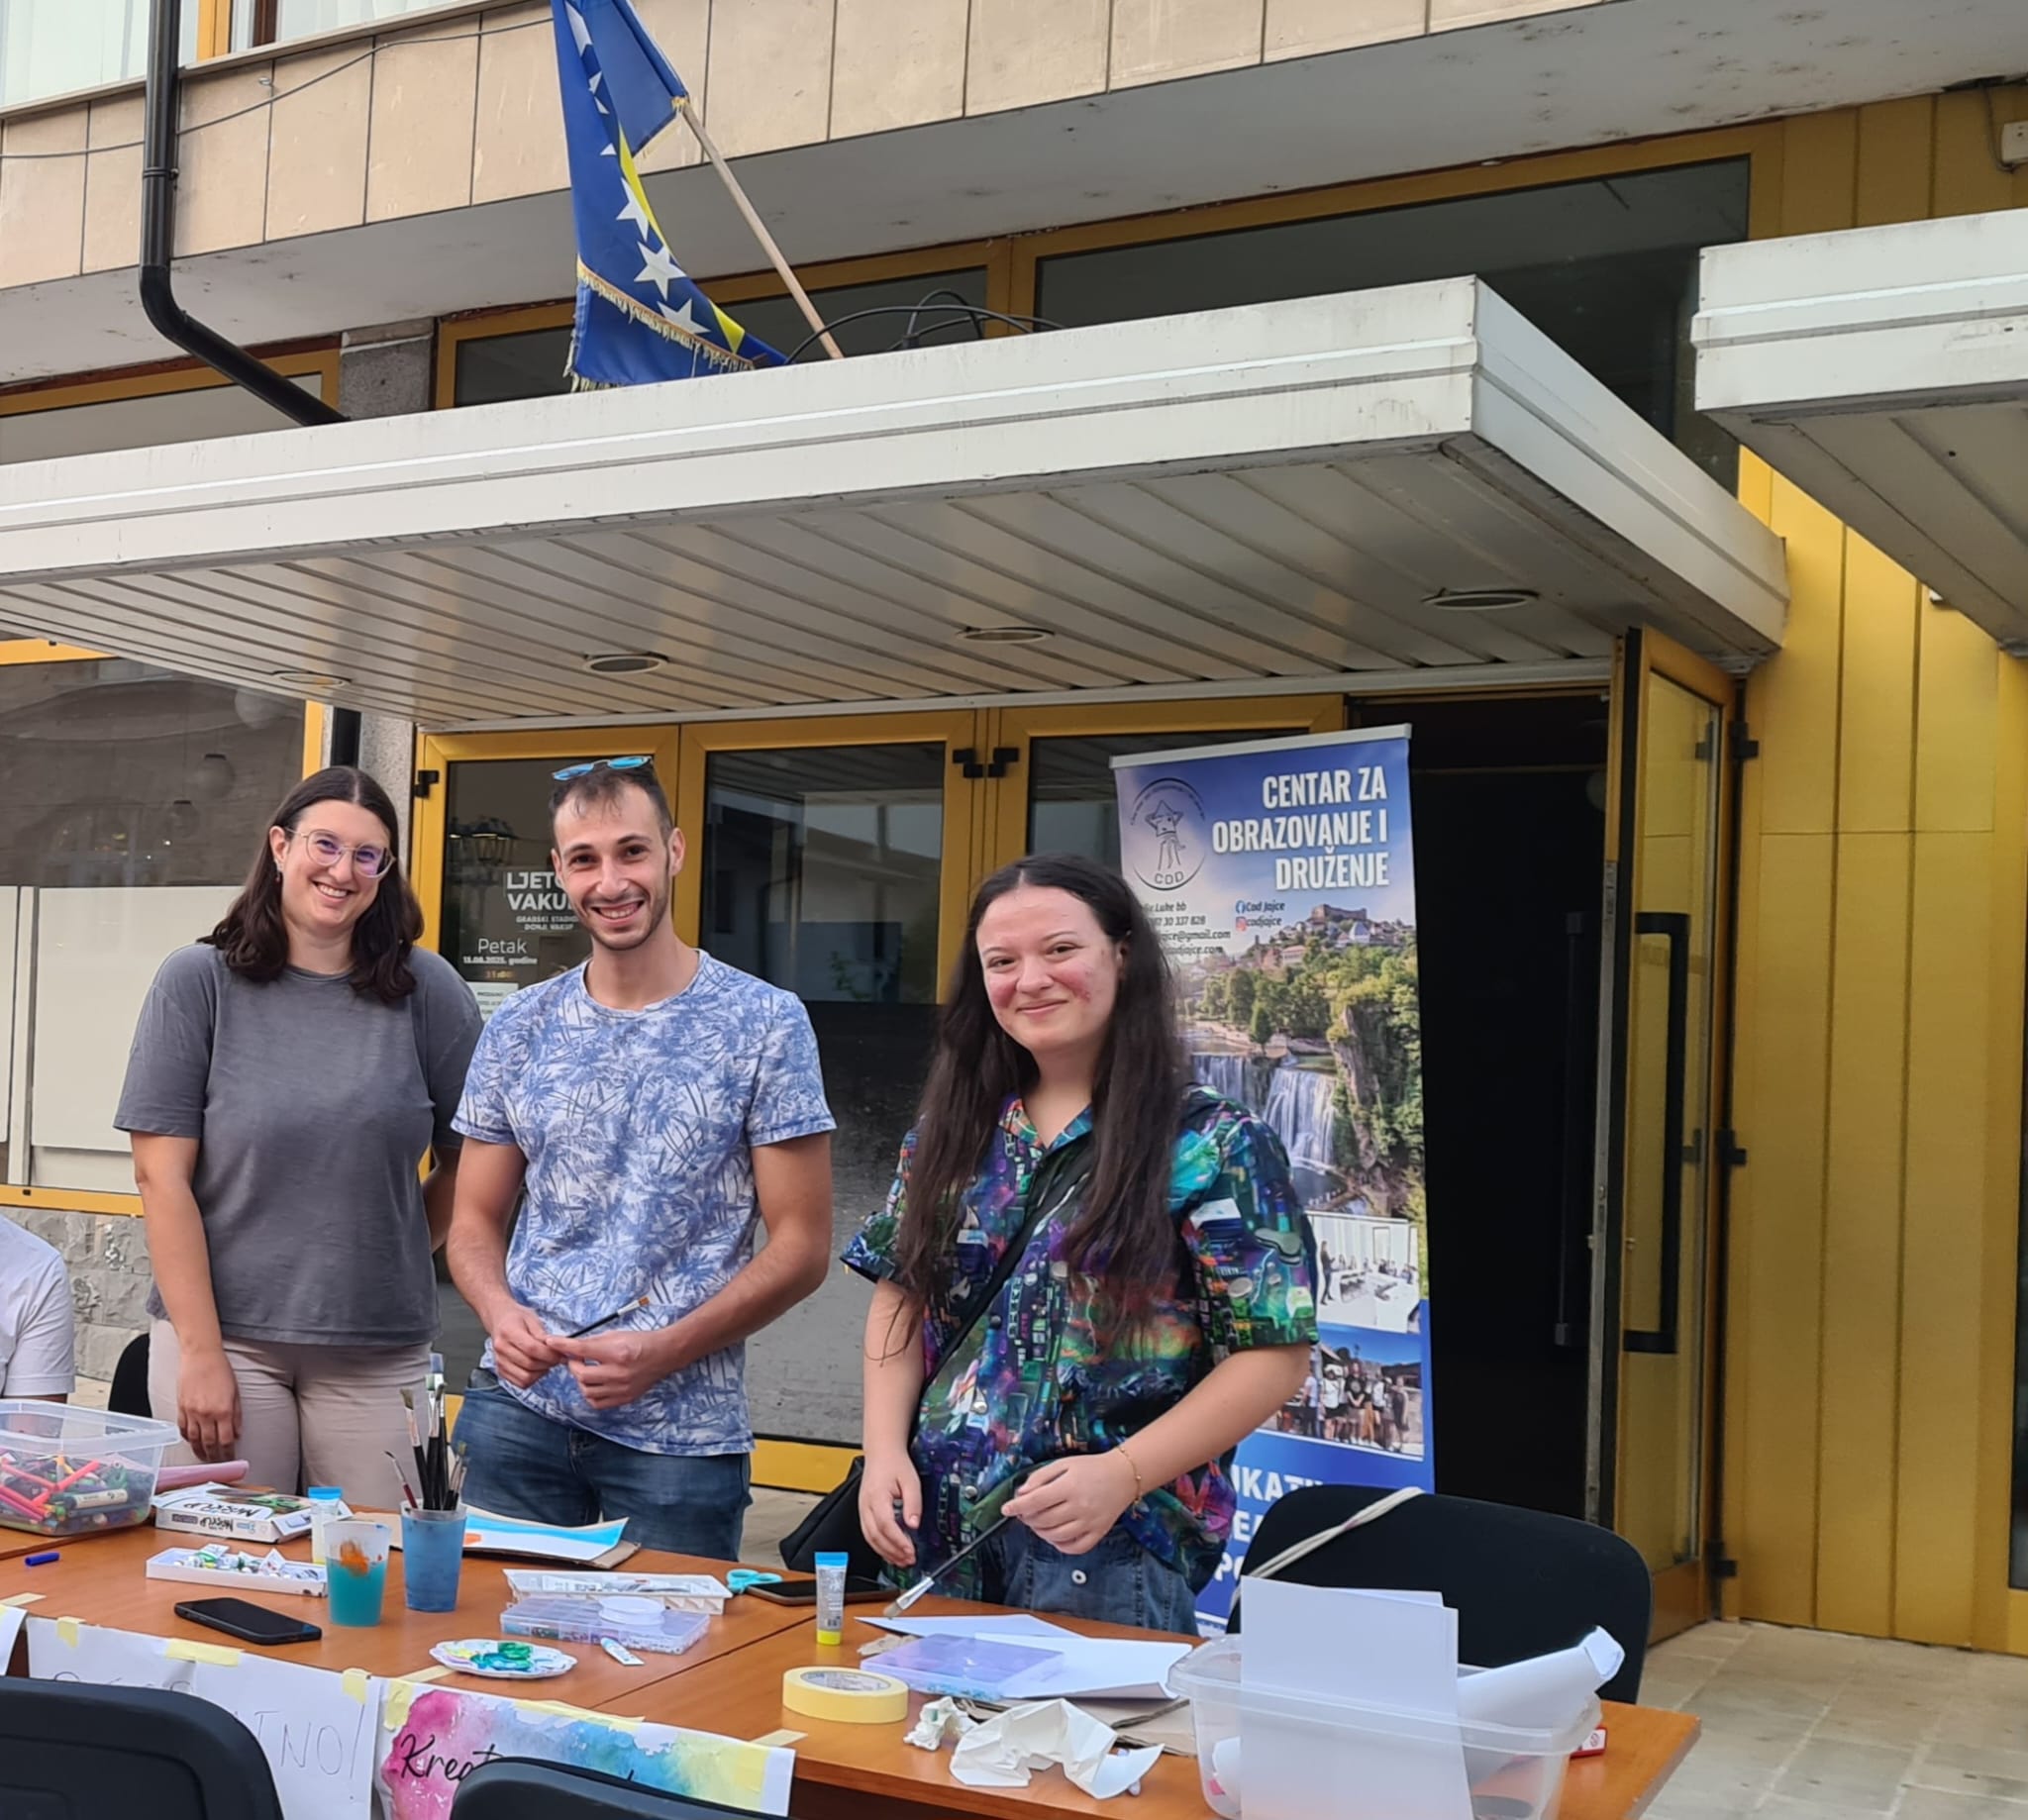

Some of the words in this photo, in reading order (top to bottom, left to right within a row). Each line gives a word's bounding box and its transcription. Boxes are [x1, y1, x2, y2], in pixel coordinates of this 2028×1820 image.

[1263, 769, 1351, 809] CENTAR
[1358, 765, 1387, 801] ZA
[1212, 810, 1372, 854] OBRAZOVANJE
[1378, 808, 1387, 843] I
[1275, 847, 1389, 891] DRUŽENJE
[477, 937, 527, 954] Petak
